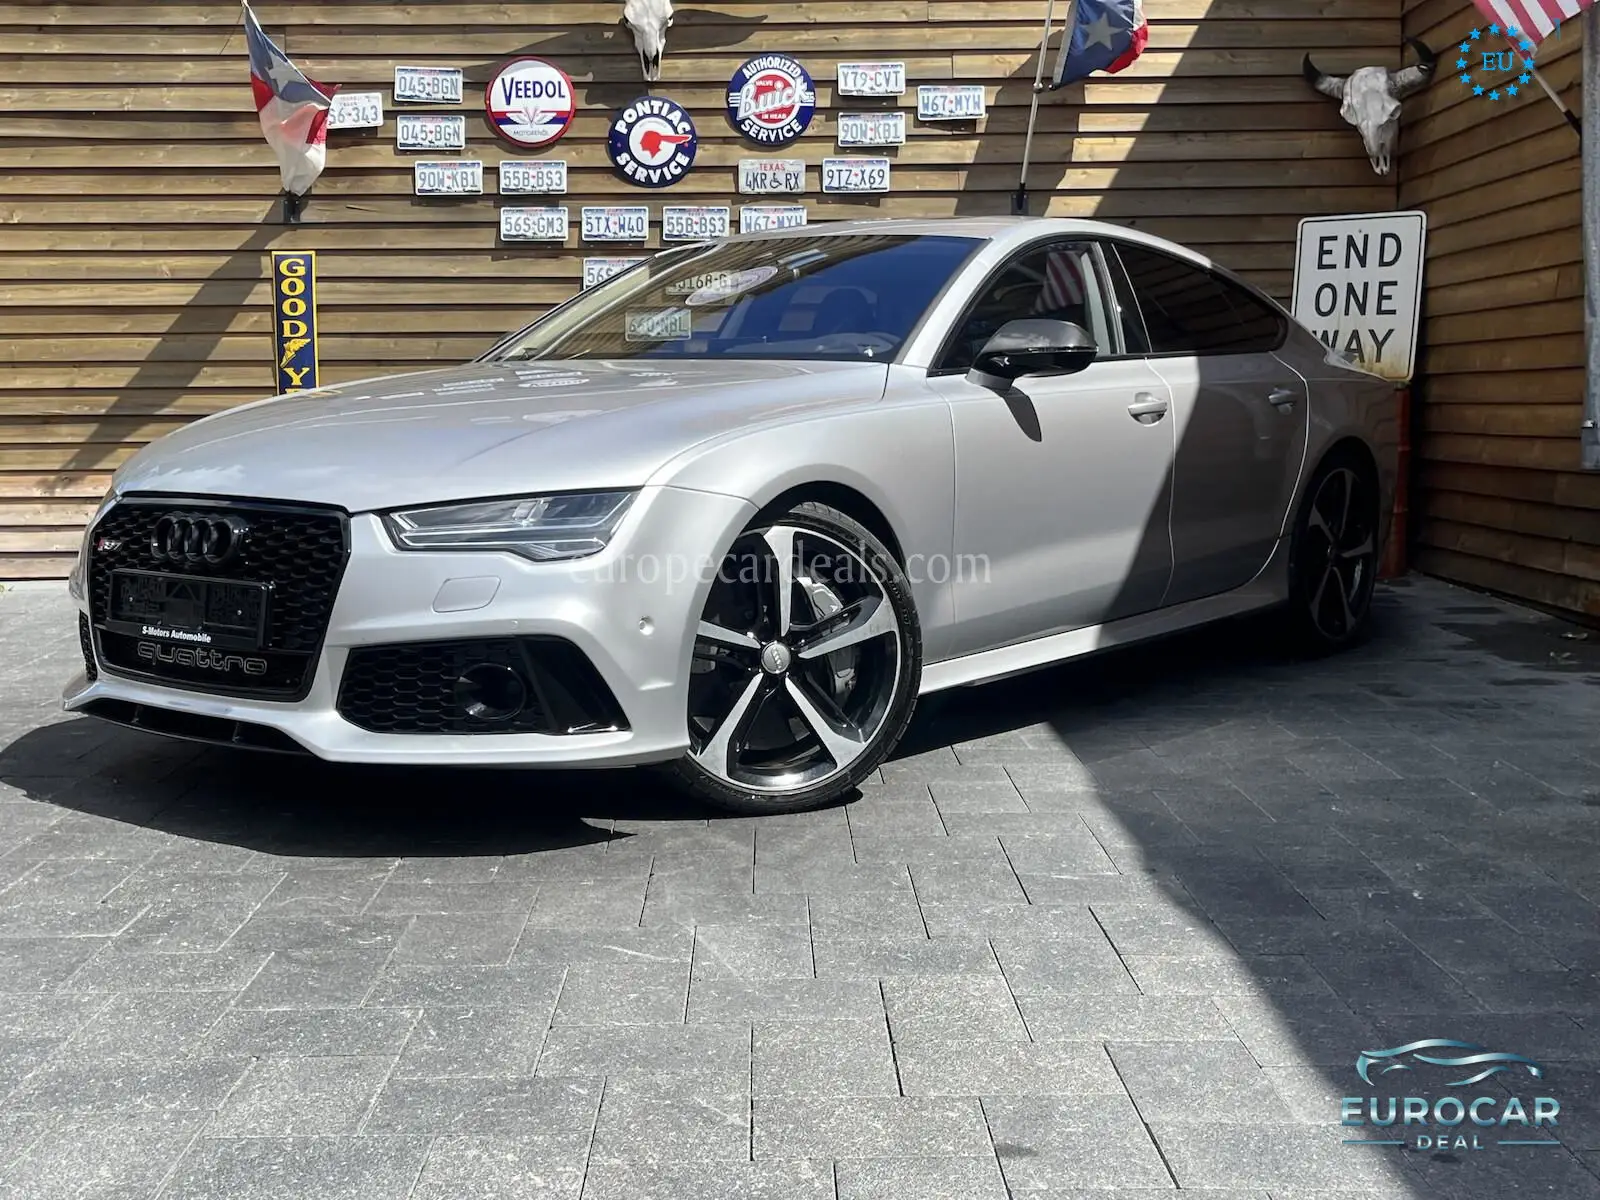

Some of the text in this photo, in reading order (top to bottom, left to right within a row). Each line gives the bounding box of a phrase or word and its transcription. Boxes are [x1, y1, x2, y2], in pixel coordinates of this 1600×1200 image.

[742, 56, 801, 79] AUTHORIZED
[501, 77, 566, 106] VEEDOL
[736, 76, 815, 120] Buick
[615, 100, 691, 134] PONTIAC
[741, 119, 802, 142] SERVICE
[616, 152, 690, 183] SERVICE
[759, 163, 785, 171] TEXAS
[1317, 233, 1402, 270] END
[1314, 281, 1398, 317] ONE
[142, 625, 212, 643] S-Motors Automobile
[137, 640, 268, 675] quattro
